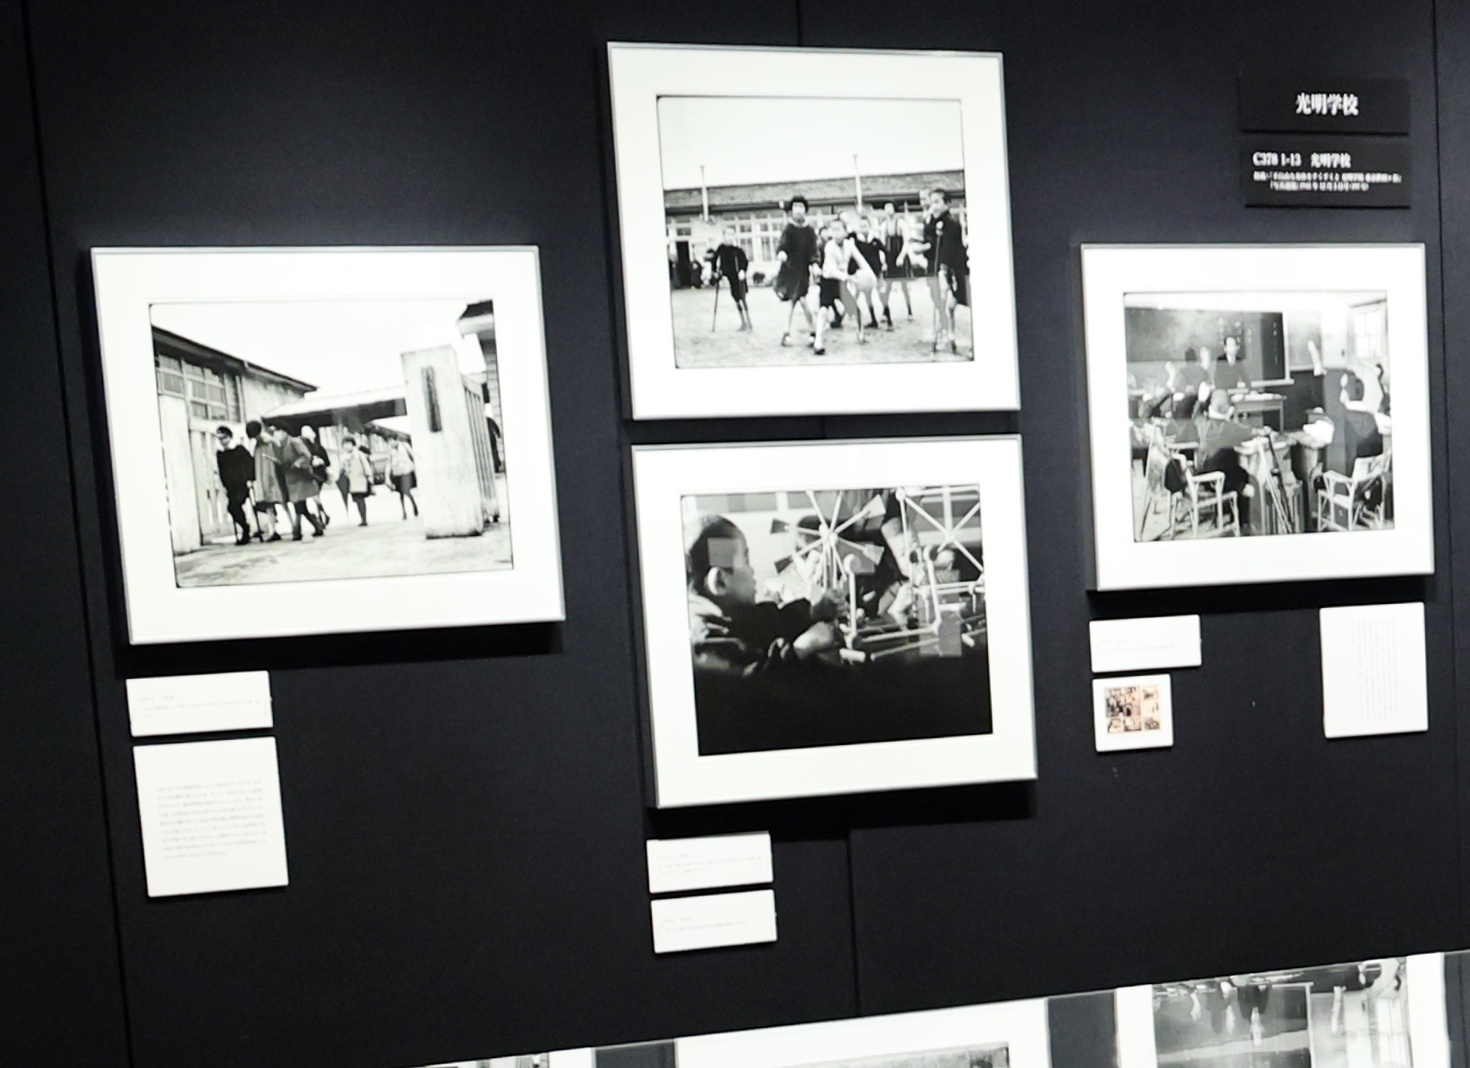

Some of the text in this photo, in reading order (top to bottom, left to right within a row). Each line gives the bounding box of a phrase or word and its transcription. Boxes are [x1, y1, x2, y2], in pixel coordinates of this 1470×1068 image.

[1296, 92, 1359, 116] 光明学校
[1310, 152, 1351, 168] 光明学校
